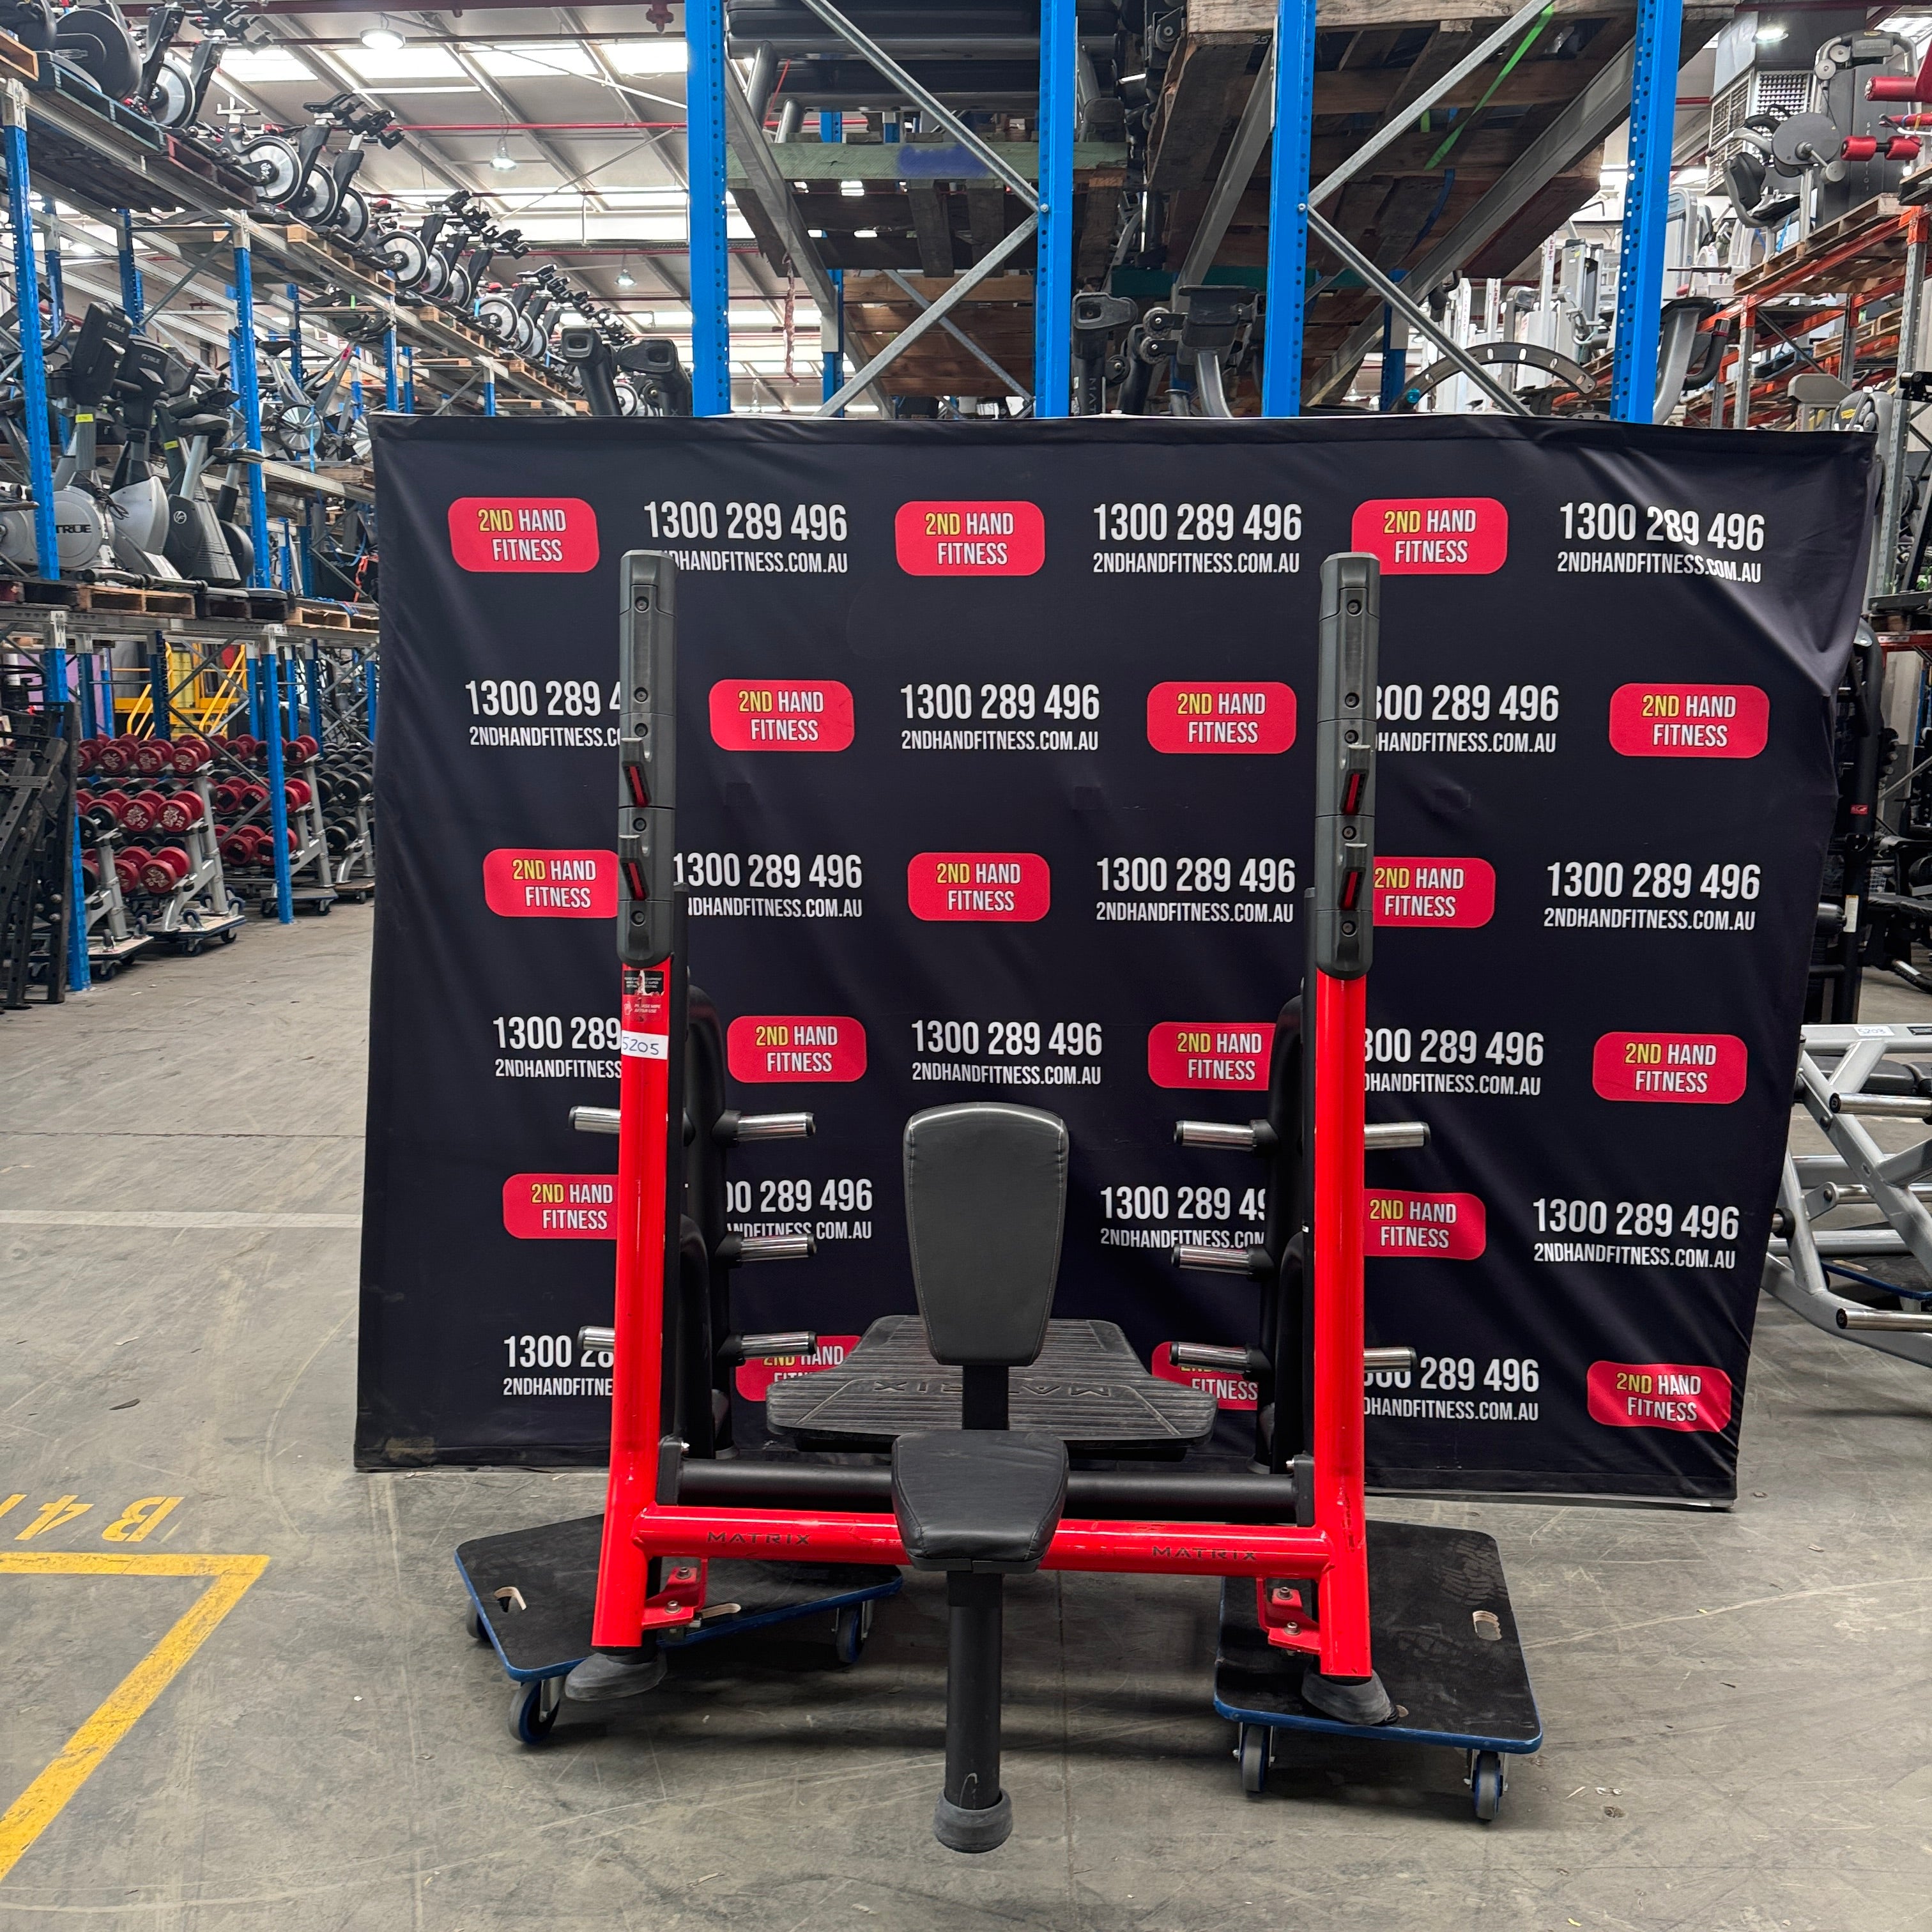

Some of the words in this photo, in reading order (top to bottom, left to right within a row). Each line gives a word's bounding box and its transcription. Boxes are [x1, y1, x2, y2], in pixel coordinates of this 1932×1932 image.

[56, 524, 92, 533] TRUE
[479, 509, 513, 531] 2ND
[519, 510, 565, 531] HAND
[645, 502, 717, 539] 1300
[726, 502, 781, 540] 289
[791, 505, 847, 540] 496
[926, 513, 960, 535] 2ND
[967, 513, 1013, 534] HAND
[1094, 503, 1167, 540] 1300
[1177, 503, 1233, 540] 289
[1243, 504, 1301, 540] 496
[1384, 511, 1420, 533] 2ND
[1427, 510, 1475, 532] HAND
[1560, 503, 1636, 540] 1300
[1647, 507, 1699, 546] 289
[1708, 513, 1764, 551] 496
[493, 539, 562, 561] FITNESS
[939, 543, 1007, 564] FITNESS
[1395, 540, 1468, 562] FITNESS
[661, 551, 847, 572] DHANDFITNESS.COM.AU
[1094, 553, 1299, 572] 2NDHANDFITNESS.COM.AU
[1557, 551, 1761, 583] 2NDHANDFITNESS.COM.AU
[466, 680, 537, 716] 1300
[546, 681, 601, 716] 289
[739, 691, 772, 712] 2ND
[778, 691, 823, 712] HAND
[901, 684, 971, 719] 1300
[981, 684, 1035, 719] 289
[1044, 684, 1099, 719] 496
[1178, 693, 1211, 714] 2ND
[1219, 694, 1265, 714] HAND
[1432, 685, 1490, 721] 289
[1499, 686, 1558, 721] 496
[1643, 695, 1679, 716] 2ND
[1686, 696, 1735, 717] HAND
[751, 719, 818, 740] FITNESS
[902, 730, 1098, 750] 2NDHANDFITNESS.COM.AU
[1189, 722, 1257, 742] FITNESS
[1654, 724, 1727, 746] FITNESS
[513, 860, 545, 879] 2ND
[551, 861, 595, 880] HAND
[674, 853, 740, 886] 1300
[748, 854, 800, 888] 289
[809, 855, 861, 888] 496
[937, 863, 969, 883] 2ND
[976, 864, 1020, 884] HAND
[1097, 857, 1167, 891] 1300
[1177, 858, 1230, 892] 289
[1239, 859, 1295, 892] 496
[1375, 868, 1409, 888] 2ND
[1416, 868, 1464, 889] HAND
[1547, 862, 1623, 897] 1300
[1633, 863, 1691, 898] 289
[1700, 864, 1760, 900] 496
[526, 887, 590, 907] FITNESS
[949, 891, 1014, 910] FITNESS
[1385, 896, 1455, 917] FITNESS
[1097, 902, 1292, 922] 2NDHANDFITNESS.COM.AU
[1544, 908, 1755, 930] 2NDHANDFITNESS.COM.AU
[493, 1016, 562, 1049] 1300
[571, 1017, 621, 1050] 289
[756, 1026, 788, 1045] 2ND
[794, 1026, 837, 1045] HAND
[912, 1020, 979, 1054] 1300
[988, 1022, 1039, 1055] 289
[1049, 1023, 1101, 1055] 496
[1178, 1032, 1210, 1052] 2ND
[1217, 1034, 1261, 1053] HAND
[622, 1036, 659, 1055] 5205
[1421, 1029, 1476, 1064] 289
[1485, 1032, 1544, 1066] 496
[1625, 1043, 1661, 1063] 2ND
[1668, 1044, 1716, 1065] HAND
[767, 1053, 832, 1071] FITNESS
[912, 1062, 1100, 1084] 2NDHANDFITNESS.COM.AU
[1189, 1059, 1255, 1080] FITNESS
[1636, 1071, 1707, 1092] FITNESS
[532, 1184, 564, 1202] 2ND
[570, 1184, 612, 1203] HAND
[760, 1180, 811, 1212] 289
[820, 1179, 872, 1211] 496
[1101, 1186, 1168, 1219] 1300
[1178, 1186, 1230, 1220] 289
[543, 1210, 607, 1229] FITNESS
[1370, 1200, 1403, 1219] 2ND
[1410, 1202, 1456, 1223] HAND
[1533, 1199, 1606, 1234] 1300
[1616, 1202, 1672, 1237] 289
[1681, 1206, 1739, 1239] 496
[1381, 1227, 1448, 1248] FITNESS
[1535, 1243, 1735, 1268] 2NDHANDFITNESS.COM.AU
[504, 1335, 571, 1367] 1300
[1421, 1357, 1474, 1390] 289
[1484, 1359, 1538, 1392] 496
[1617, 1373, 1652, 1393] 2ND
[1659, 1375, 1701, 1395] HAND
[1629, 1397, 1697, 1421] FITNESS
[707, 1531, 810, 1545] MATRIX
[1152, 1546, 1257, 1560] MATRIX
